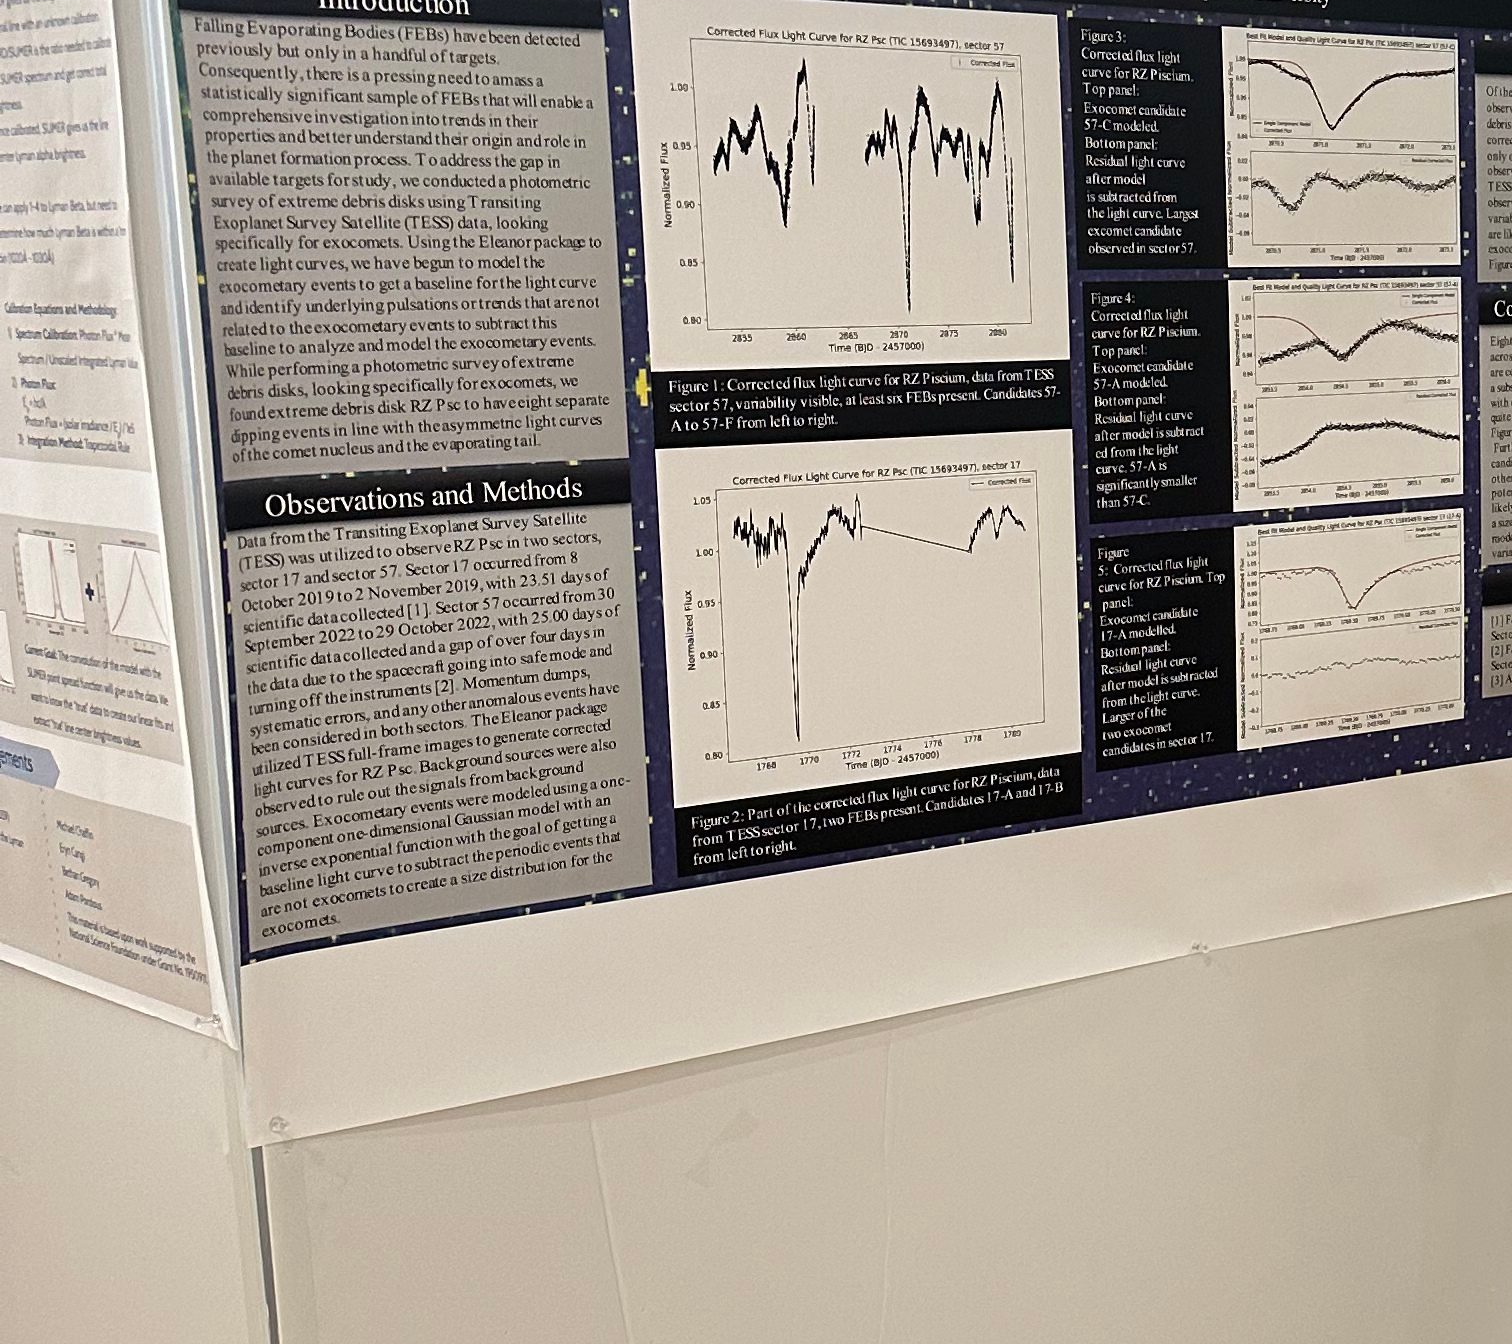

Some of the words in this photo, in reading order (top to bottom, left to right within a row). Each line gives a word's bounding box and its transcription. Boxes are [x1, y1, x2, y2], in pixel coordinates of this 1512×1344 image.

[194, 16, 244, 38] Falling
[247, 19, 341, 41] Evaporating
[344, 23, 395, 39] Bodies
[397, 26, 449, 44] (FEBs)
[452, 27, 486, 43] have
[488, 29, 520, 44] been
[524, 31, 580, 47] detected
[1080, 28, 1113, 44] Figure
[1115, 30, 1126, 43] 3:
[196, 42, 272, 61] previously
[276, 42, 299, 58] but
[304, 44, 339, 63] only
[342, 45, 356, 60] in
[360, 50, 368, 60] a
[372, 46, 426, 62] handful
[430, 48, 447, 63] of
[449, 51, 499, 68] targets.
[1081, 46, 1133, 61] Corrected
[1135, 49, 1155, 62] flux
[1157, 50, 1180, 66] light
[198, 61, 303, 83] Consequently,
[306, 65, 344, 81] there
[347, 71, 359, 81] is
[362, 71, 370, 81] a
[374, 72, 436, 87] pressing
[438, 71, 472, 84] need
[475, 73, 489, 85] to
[492, 75, 533, 86] amass
[536, 77, 543, 87] a
[1081, 68, 1111, 78] curve
[1113, 66, 1130, 79] for
[1132, 67, 1148, 80] RZ
[1150, 68, 1193, 82] Piscium.
[1090, 292, 1122, 307] Figure
[1124, 292, 1134, 303] 4:
[668, 379, 708, 396] Figure
[713, 379, 724, 391] 1:
[727, 376, 790, 391] Corrected
[793, 376, 816, 388] flux
[819, 375, 846, 391] light
[848, 377, 880, 387] curve
[884, 373, 899, 385] for
[902, 372, 919, 385] RZ
[922, 372, 968, 384] Piscium,
[971, 370, 993, 382] data
[997, 369, 1023, 381] from
[1024, 368, 1054, 380] TESS
[232, 447, 246, 463] of
[247, 447, 269, 461] the
[272, 446, 317, 459] comet
[319, 441, 374, 457] nucleus
[377, 439, 403, 453] and
[406, 438, 429, 452] the
[432, 437, 512, 453] evaporating
[265, 486, 424, 517] Observations
[432, 482, 473, 506] and
[482, 476, 582, 502] Methods
[237, 531, 266, 550] Data
[269, 531, 305, 546] from
[307, 528, 330, 542] the
[333, 523, 407, 540] Transiting
[409, 516, 478, 537] Exoplanet
[482, 517, 528, 531] Survey
[533, 511, 587, 527] Satellite
[1097, 547, 1129, 561] Figure
[1097, 564, 1108, 576] 5:
[1113, 563, 1162, 574] Corrected
[1165, 558, 1183, 570] flux
[1186, 556, 1208, 570] light
[691, 815, 729, 830] Figure
[731, 810, 744, 823] 2:
[747, 807, 773, 820] Part
[776, 802, 791, 816] of
[793, 801, 811, 813] the
[815, 792, 865, 811] corrected
[867, 790, 888, 803] flux
[892, 785, 917, 801] light
[920, 783, 950, 795] curve
[952, 778, 970, 790] for
[971, 775, 987, 788] RZ
[990, 771, 1036, 785] Piscium,
[1038, 766, 1059, 778] data
